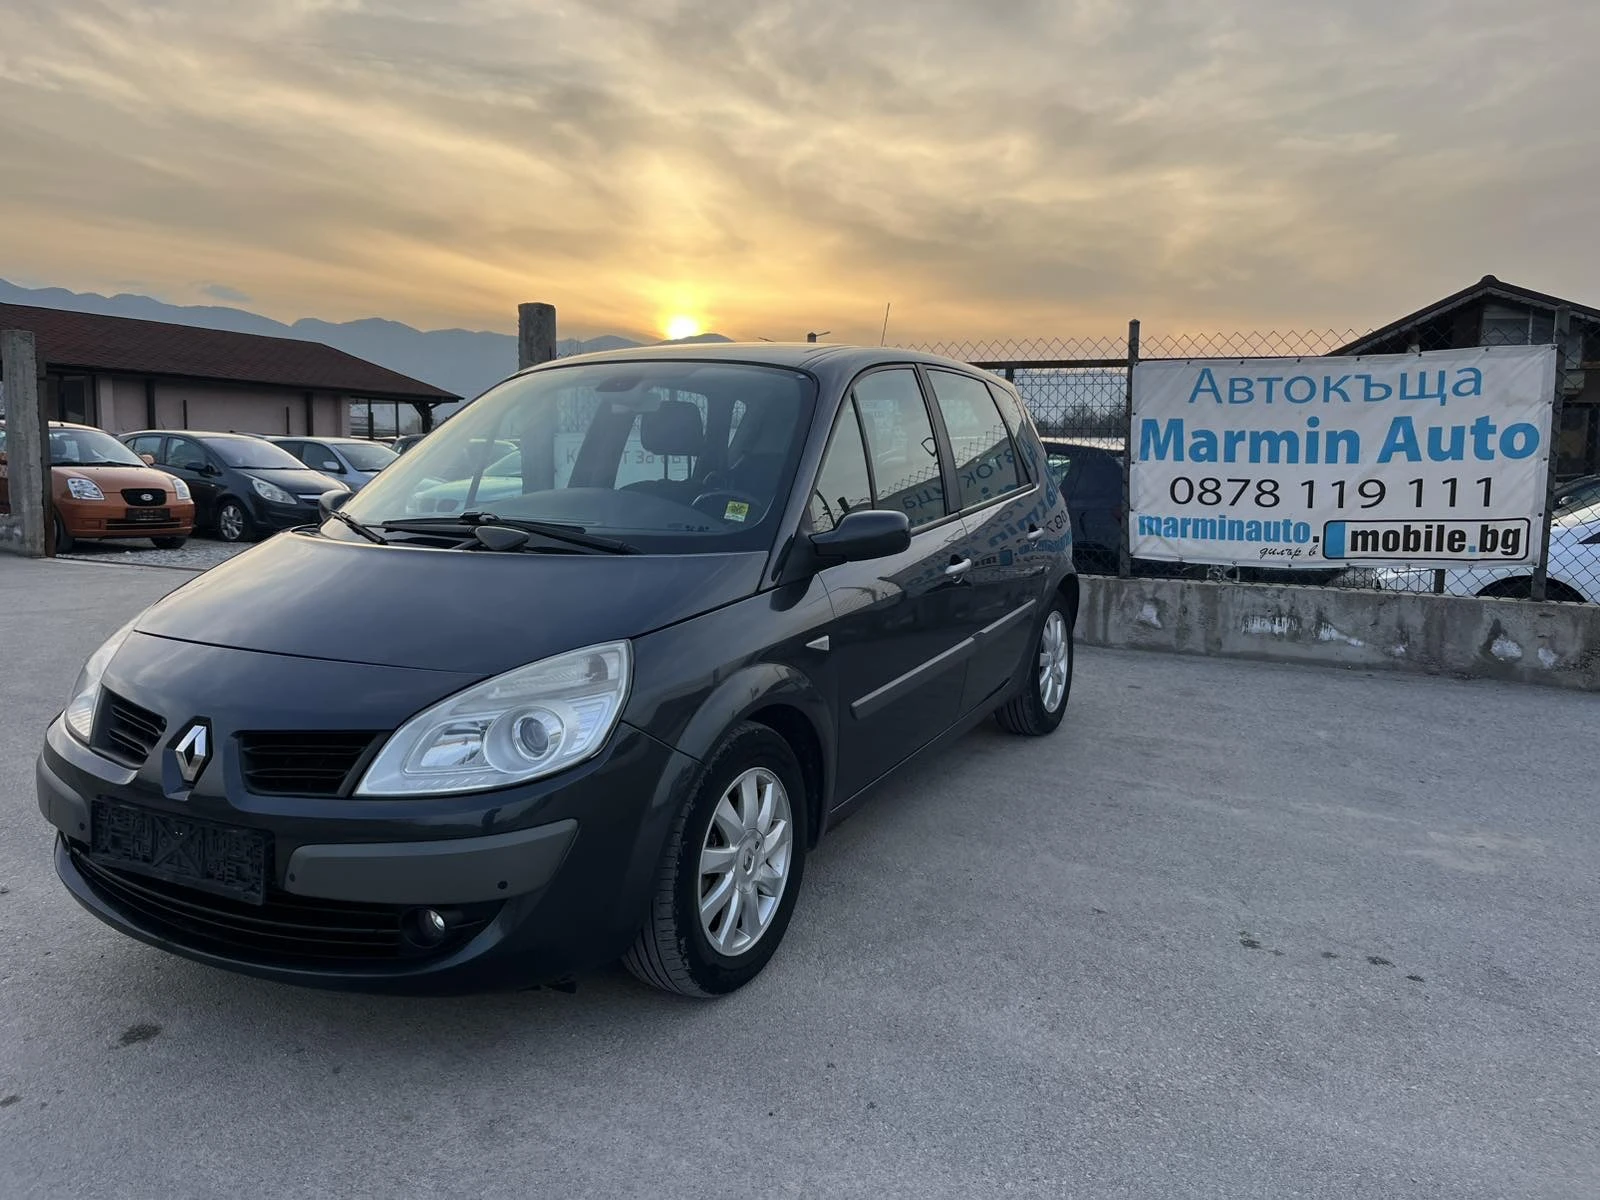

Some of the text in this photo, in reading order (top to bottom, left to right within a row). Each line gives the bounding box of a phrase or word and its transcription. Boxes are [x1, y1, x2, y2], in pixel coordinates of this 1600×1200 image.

[1188, 367, 1482, 407] Автокъща
[1138, 415, 1540, 465] Marmin Auto
[1169, 476, 1493, 509] 0878 119 111
[1350, 523, 1522, 556] mobile.bg
